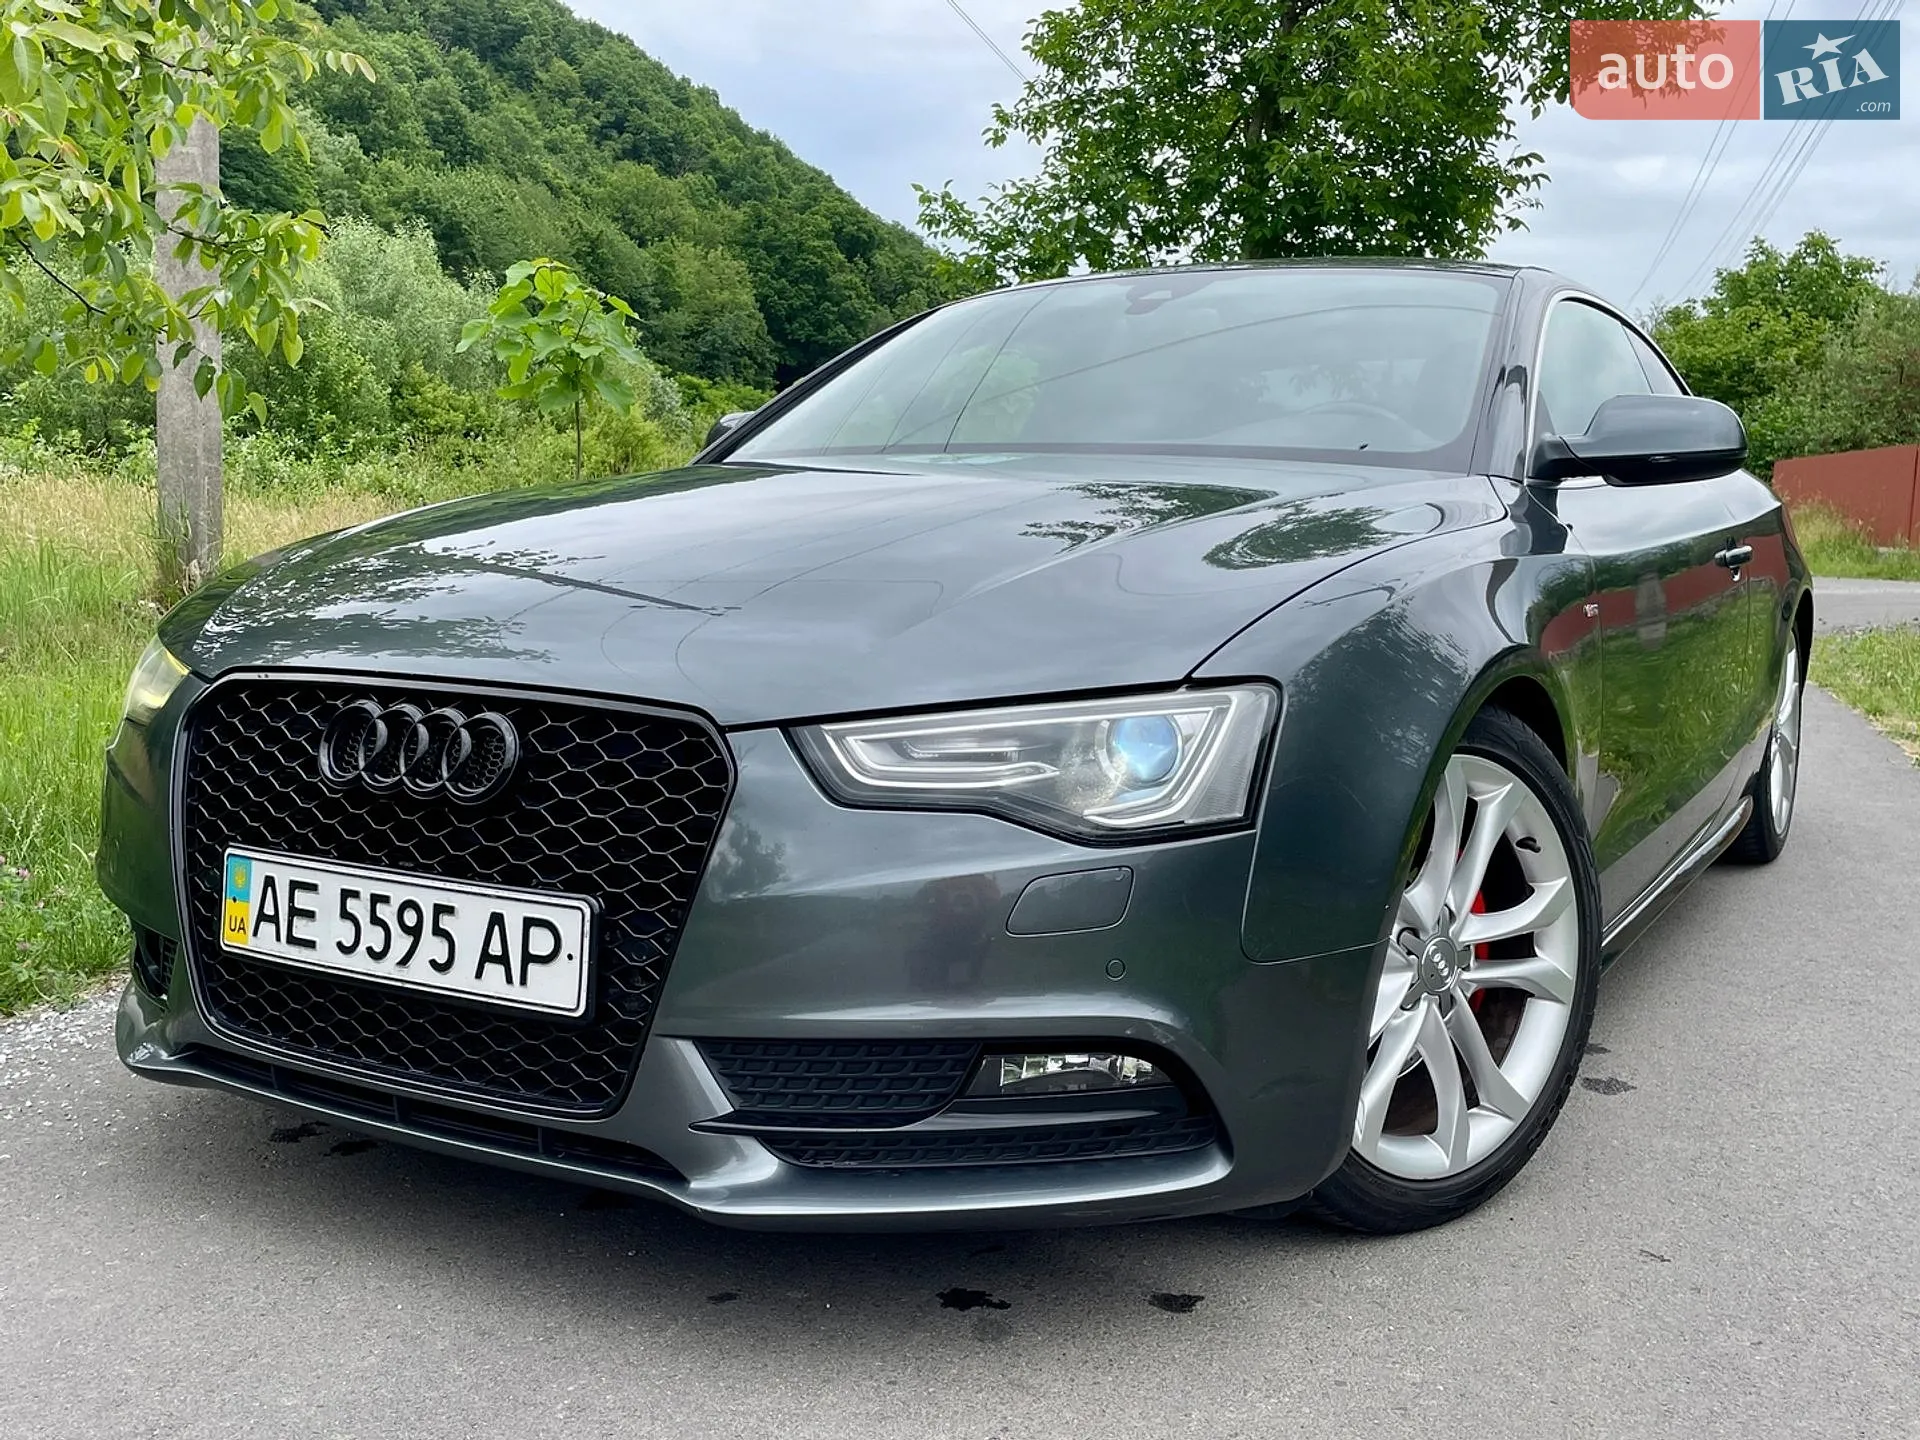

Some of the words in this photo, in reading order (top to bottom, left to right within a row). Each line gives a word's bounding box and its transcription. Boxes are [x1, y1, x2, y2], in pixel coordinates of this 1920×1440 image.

[229, 915, 247, 935] UA
[252, 875, 319, 949] AE
[336, 887, 456, 973] 5595
[474, 911, 562, 987] AP
